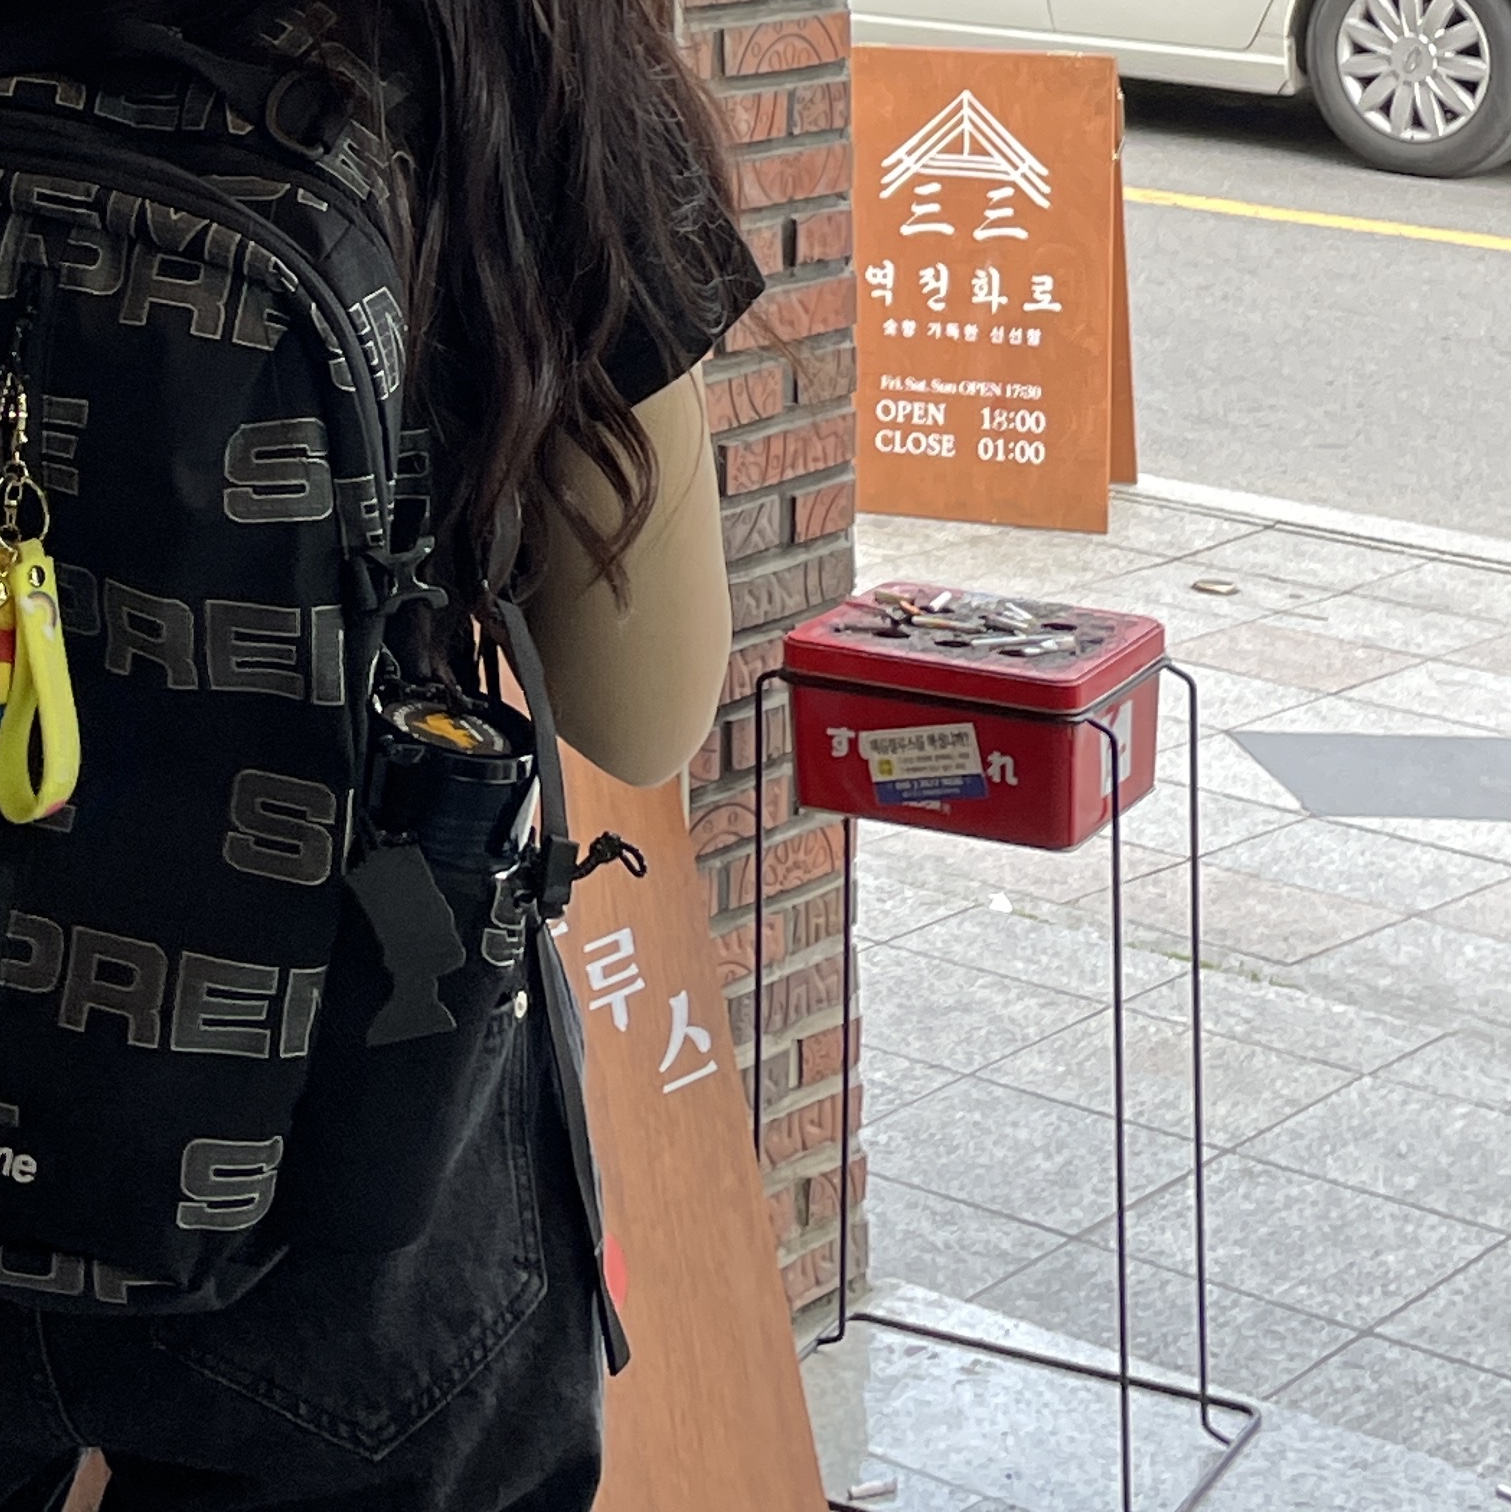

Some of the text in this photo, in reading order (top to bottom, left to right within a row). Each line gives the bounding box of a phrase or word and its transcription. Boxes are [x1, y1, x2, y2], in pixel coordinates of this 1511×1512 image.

[875, 399, 1046, 434] OPEN 18:00
[958, 380, 1002, 397] OPEN
[223, 416, 335, 524] S
[875, 429, 1046, 465] CLOSE 01:00
[224, 768, 336, 886] S
[176, 1135, 284, 1230] S
